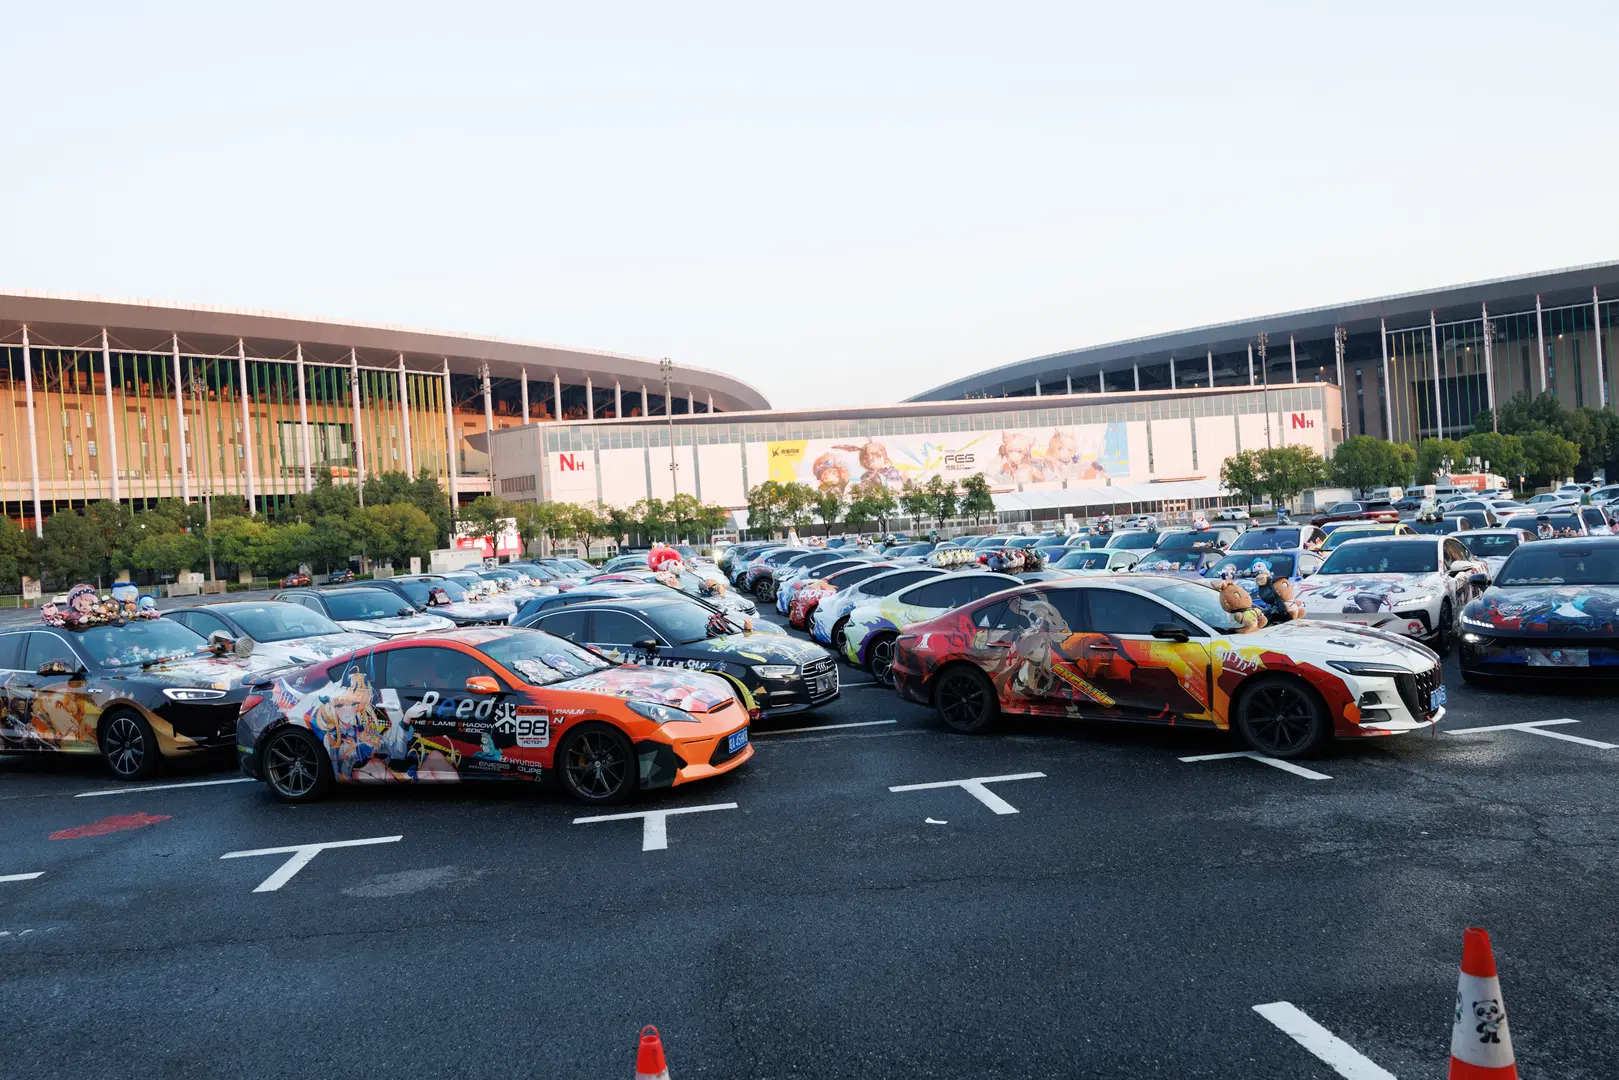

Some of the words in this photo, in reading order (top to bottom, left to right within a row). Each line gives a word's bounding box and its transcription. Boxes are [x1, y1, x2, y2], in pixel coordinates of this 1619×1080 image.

[945, 454, 975, 464] FES
[422, 691, 496, 719] Reed
[518, 720, 547, 736] 98
[510, 758, 542, 768] HYUNDAI
